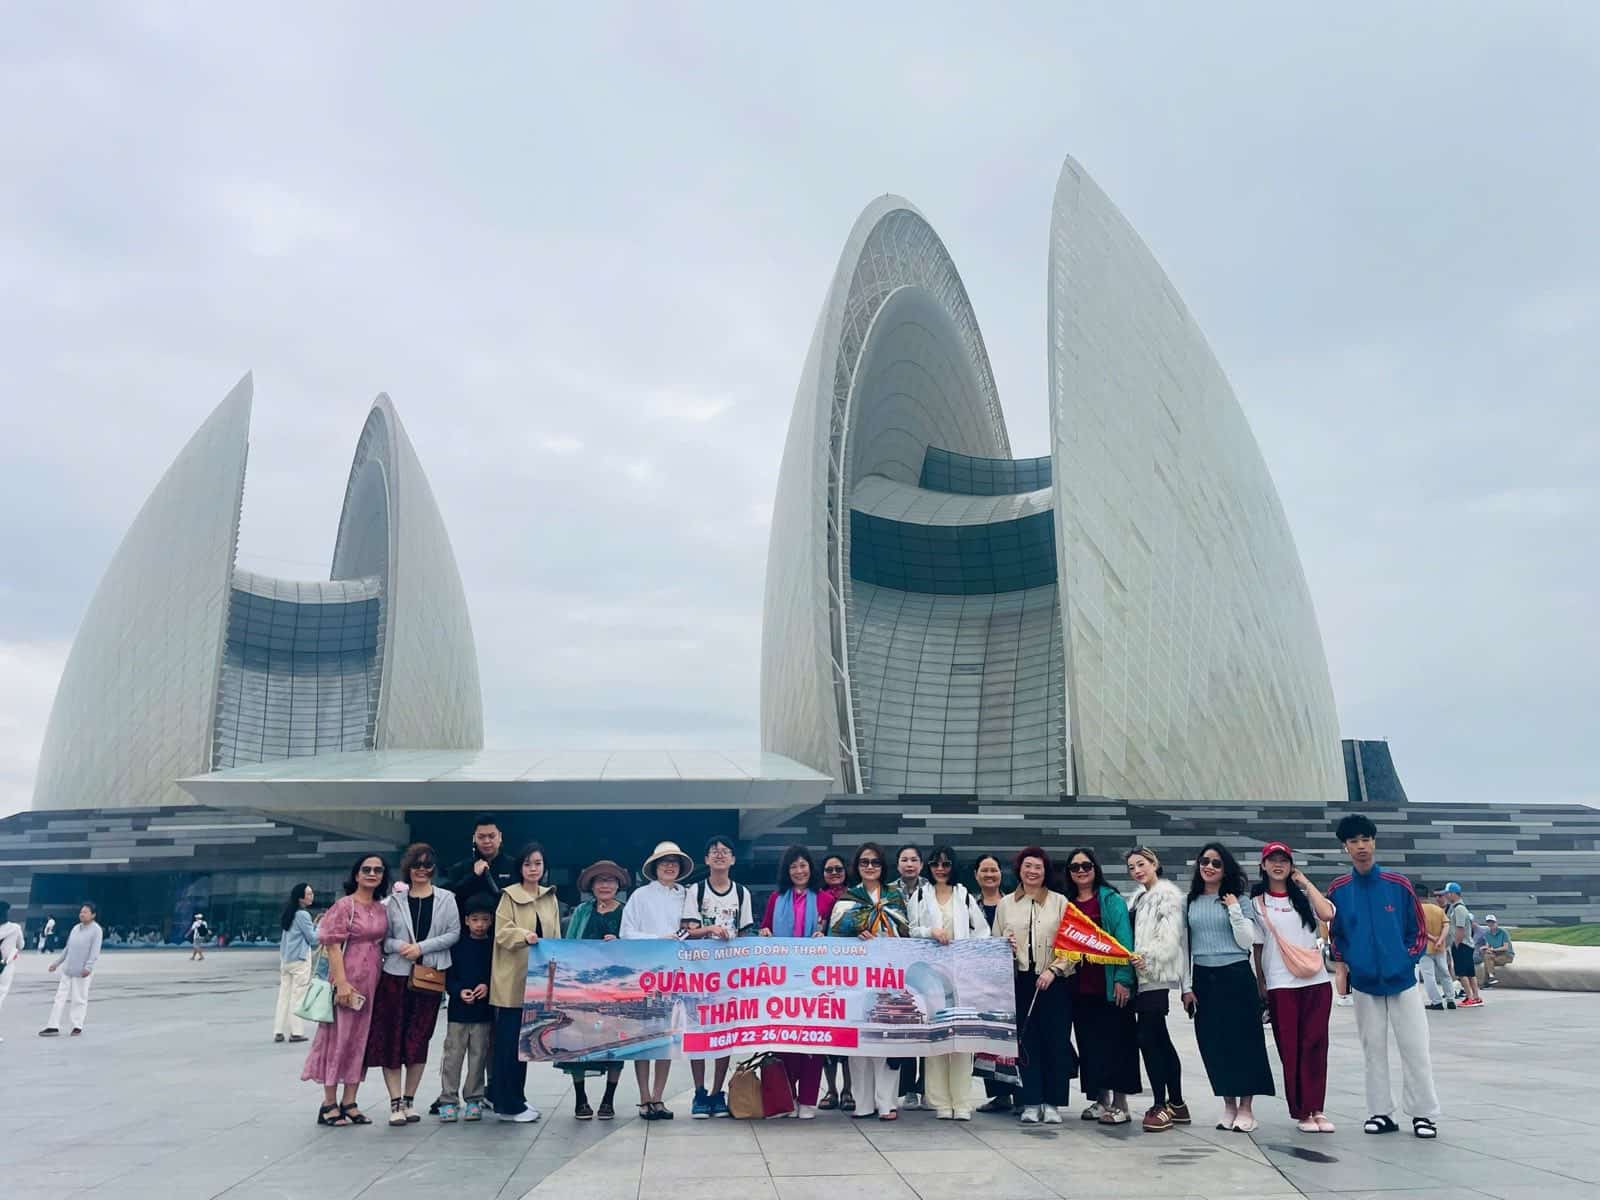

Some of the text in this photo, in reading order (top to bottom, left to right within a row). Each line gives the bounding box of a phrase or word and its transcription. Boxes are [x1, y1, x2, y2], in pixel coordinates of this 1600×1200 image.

[639, 966, 721, 993] QUẢNG
[727, 962, 787, 989] CHÂU
[811, 965, 859, 987] CHU
[865, 962, 905, 990] HẢI
[696, 996, 759, 1026] THÂM
